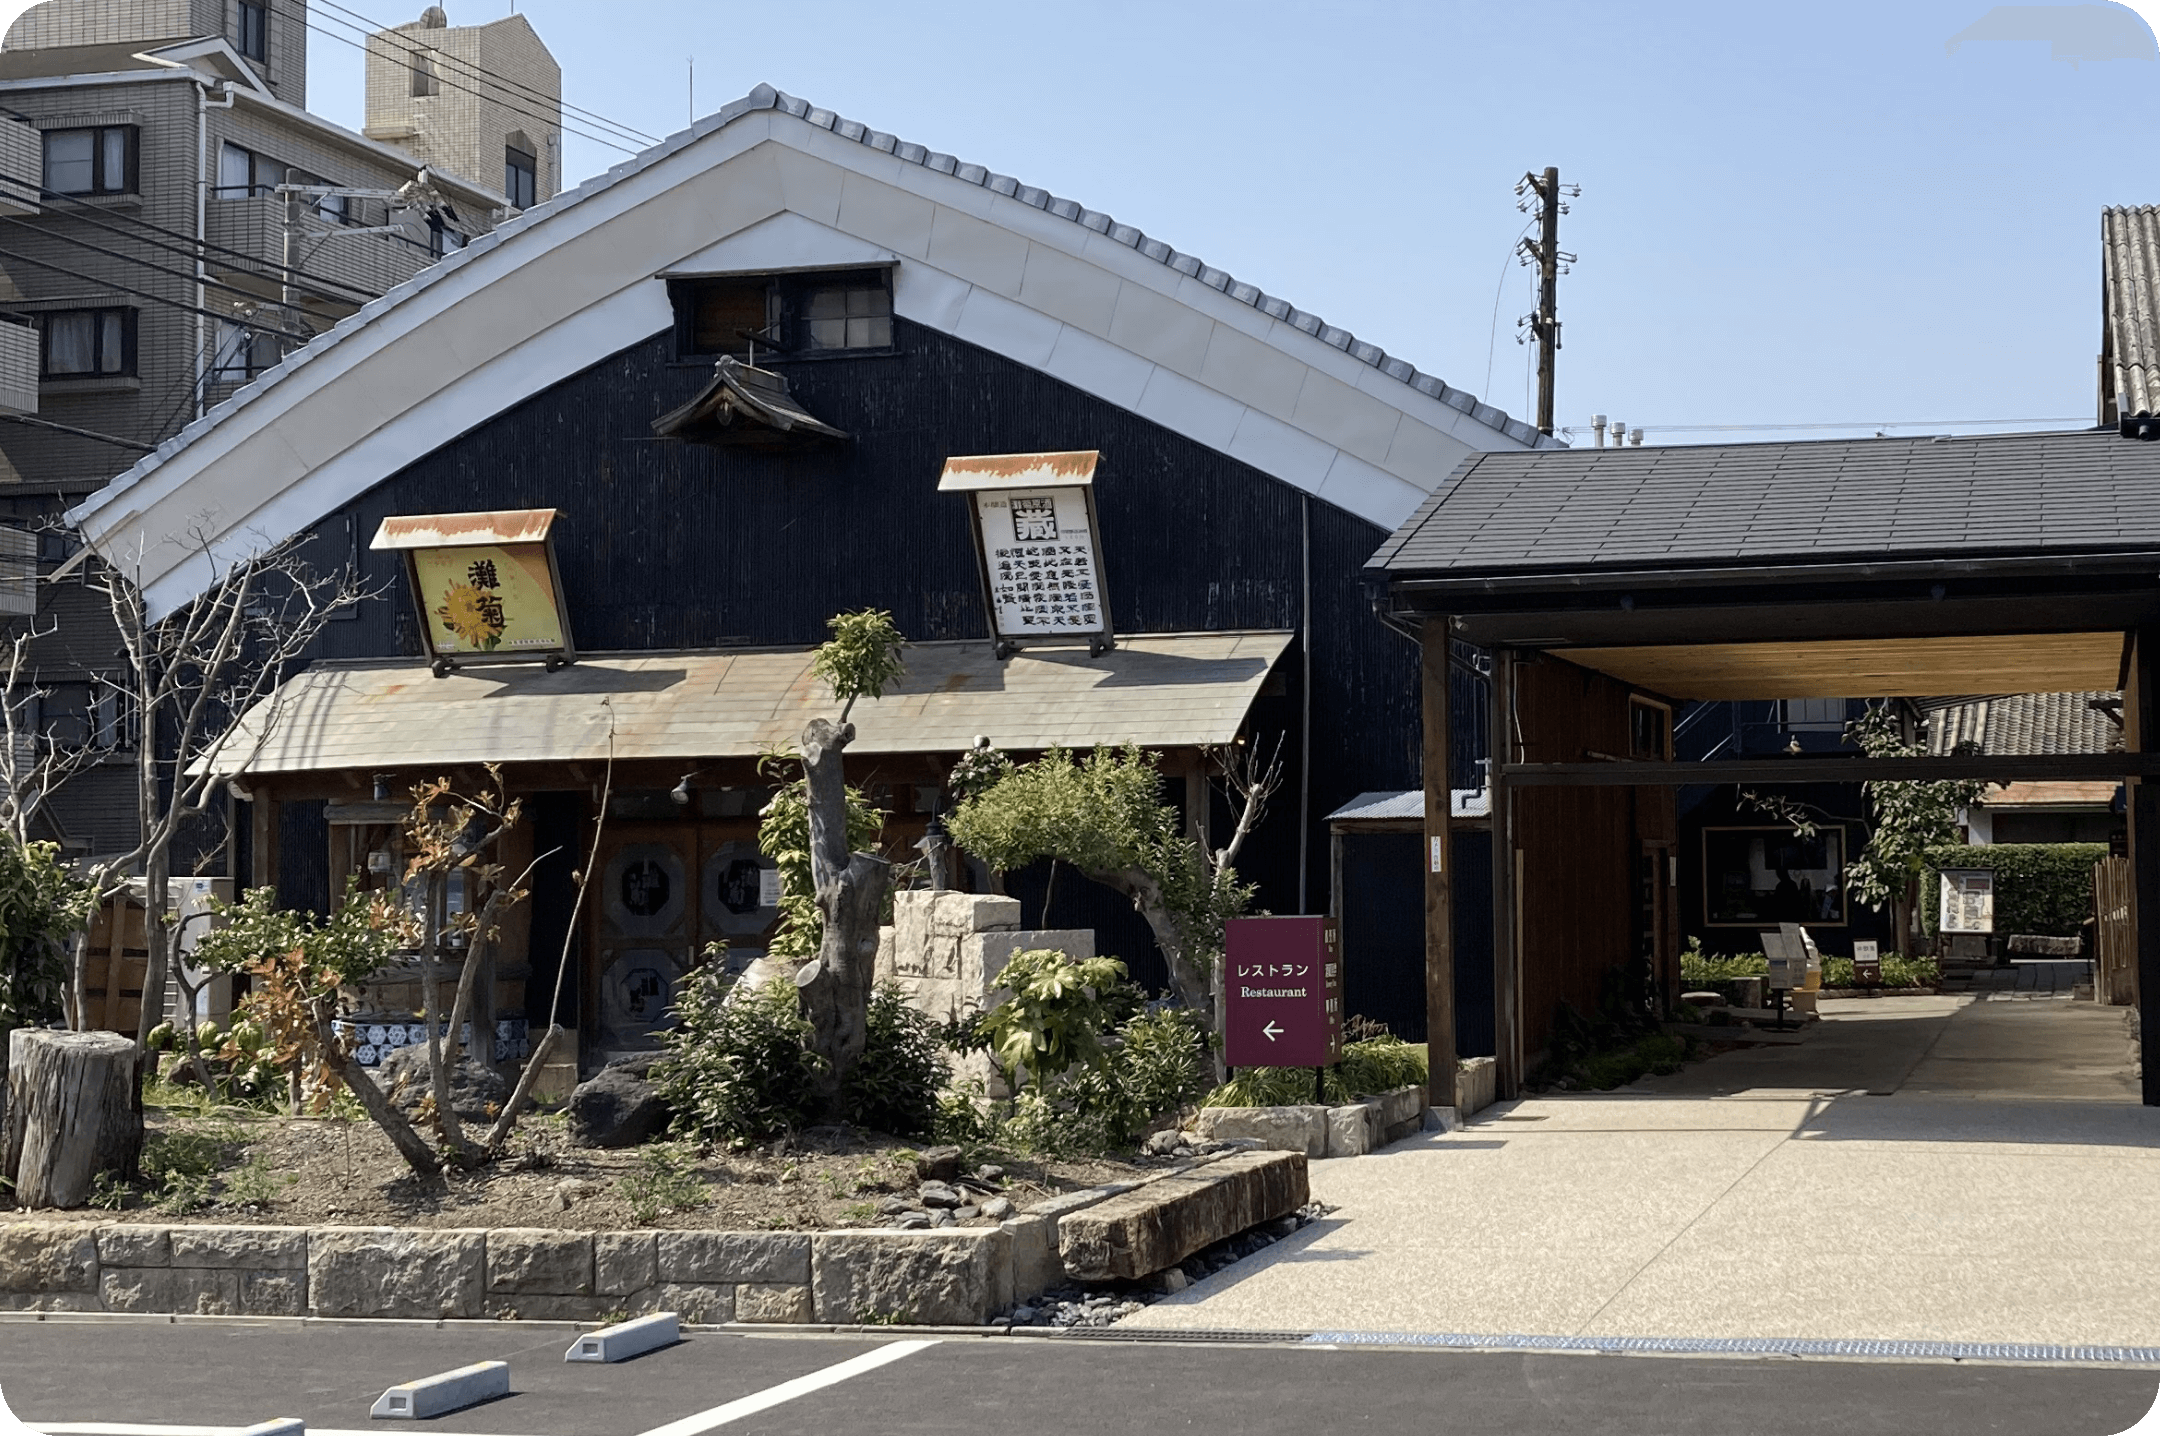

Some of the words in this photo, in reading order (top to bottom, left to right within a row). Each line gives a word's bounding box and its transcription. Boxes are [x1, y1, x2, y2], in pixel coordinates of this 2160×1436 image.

[467, 559, 506, 628] 灘菊
[1237, 964, 1309, 977] レストラン
[1240, 986, 1308, 998] Restaurant
